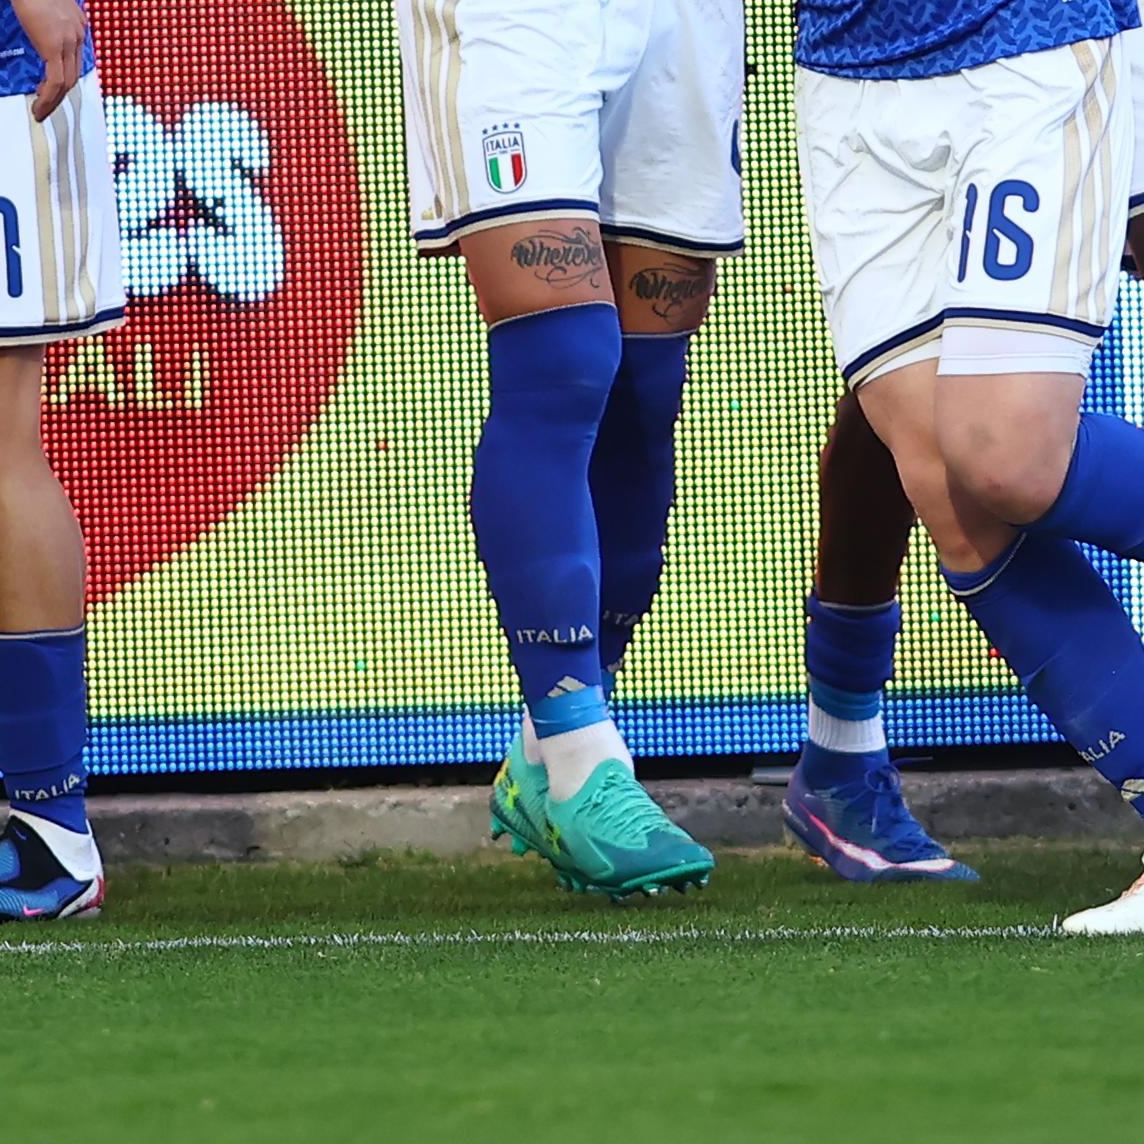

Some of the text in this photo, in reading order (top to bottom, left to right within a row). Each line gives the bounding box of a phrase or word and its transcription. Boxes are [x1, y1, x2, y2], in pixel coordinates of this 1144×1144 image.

[486, 136, 520, 153] ITALIA
[957, 179, 1040, 283] 16
[516, 624, 594, 644] ITALIA
[14, 773, 81, 801] ITALIA
